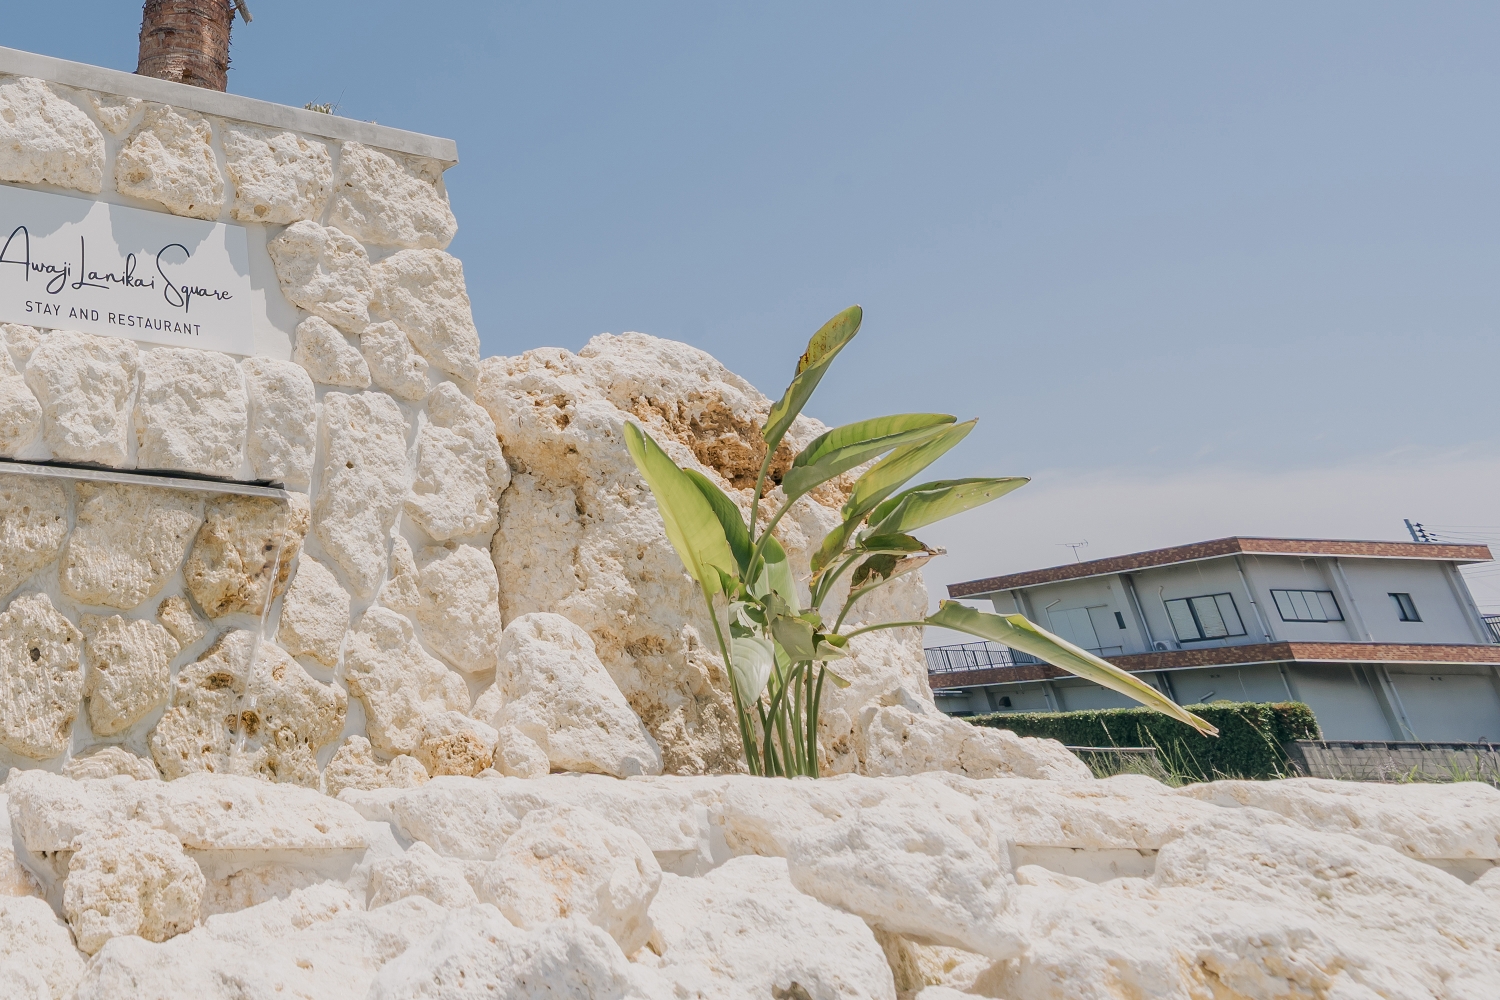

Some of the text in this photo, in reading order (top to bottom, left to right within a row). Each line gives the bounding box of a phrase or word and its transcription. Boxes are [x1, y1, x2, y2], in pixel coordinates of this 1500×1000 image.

[71, 235, 155, 290] Lanikai
[155, 243, 233, 313] Square
[25, 300, 201, 336] STAY AND RESTAURANT
